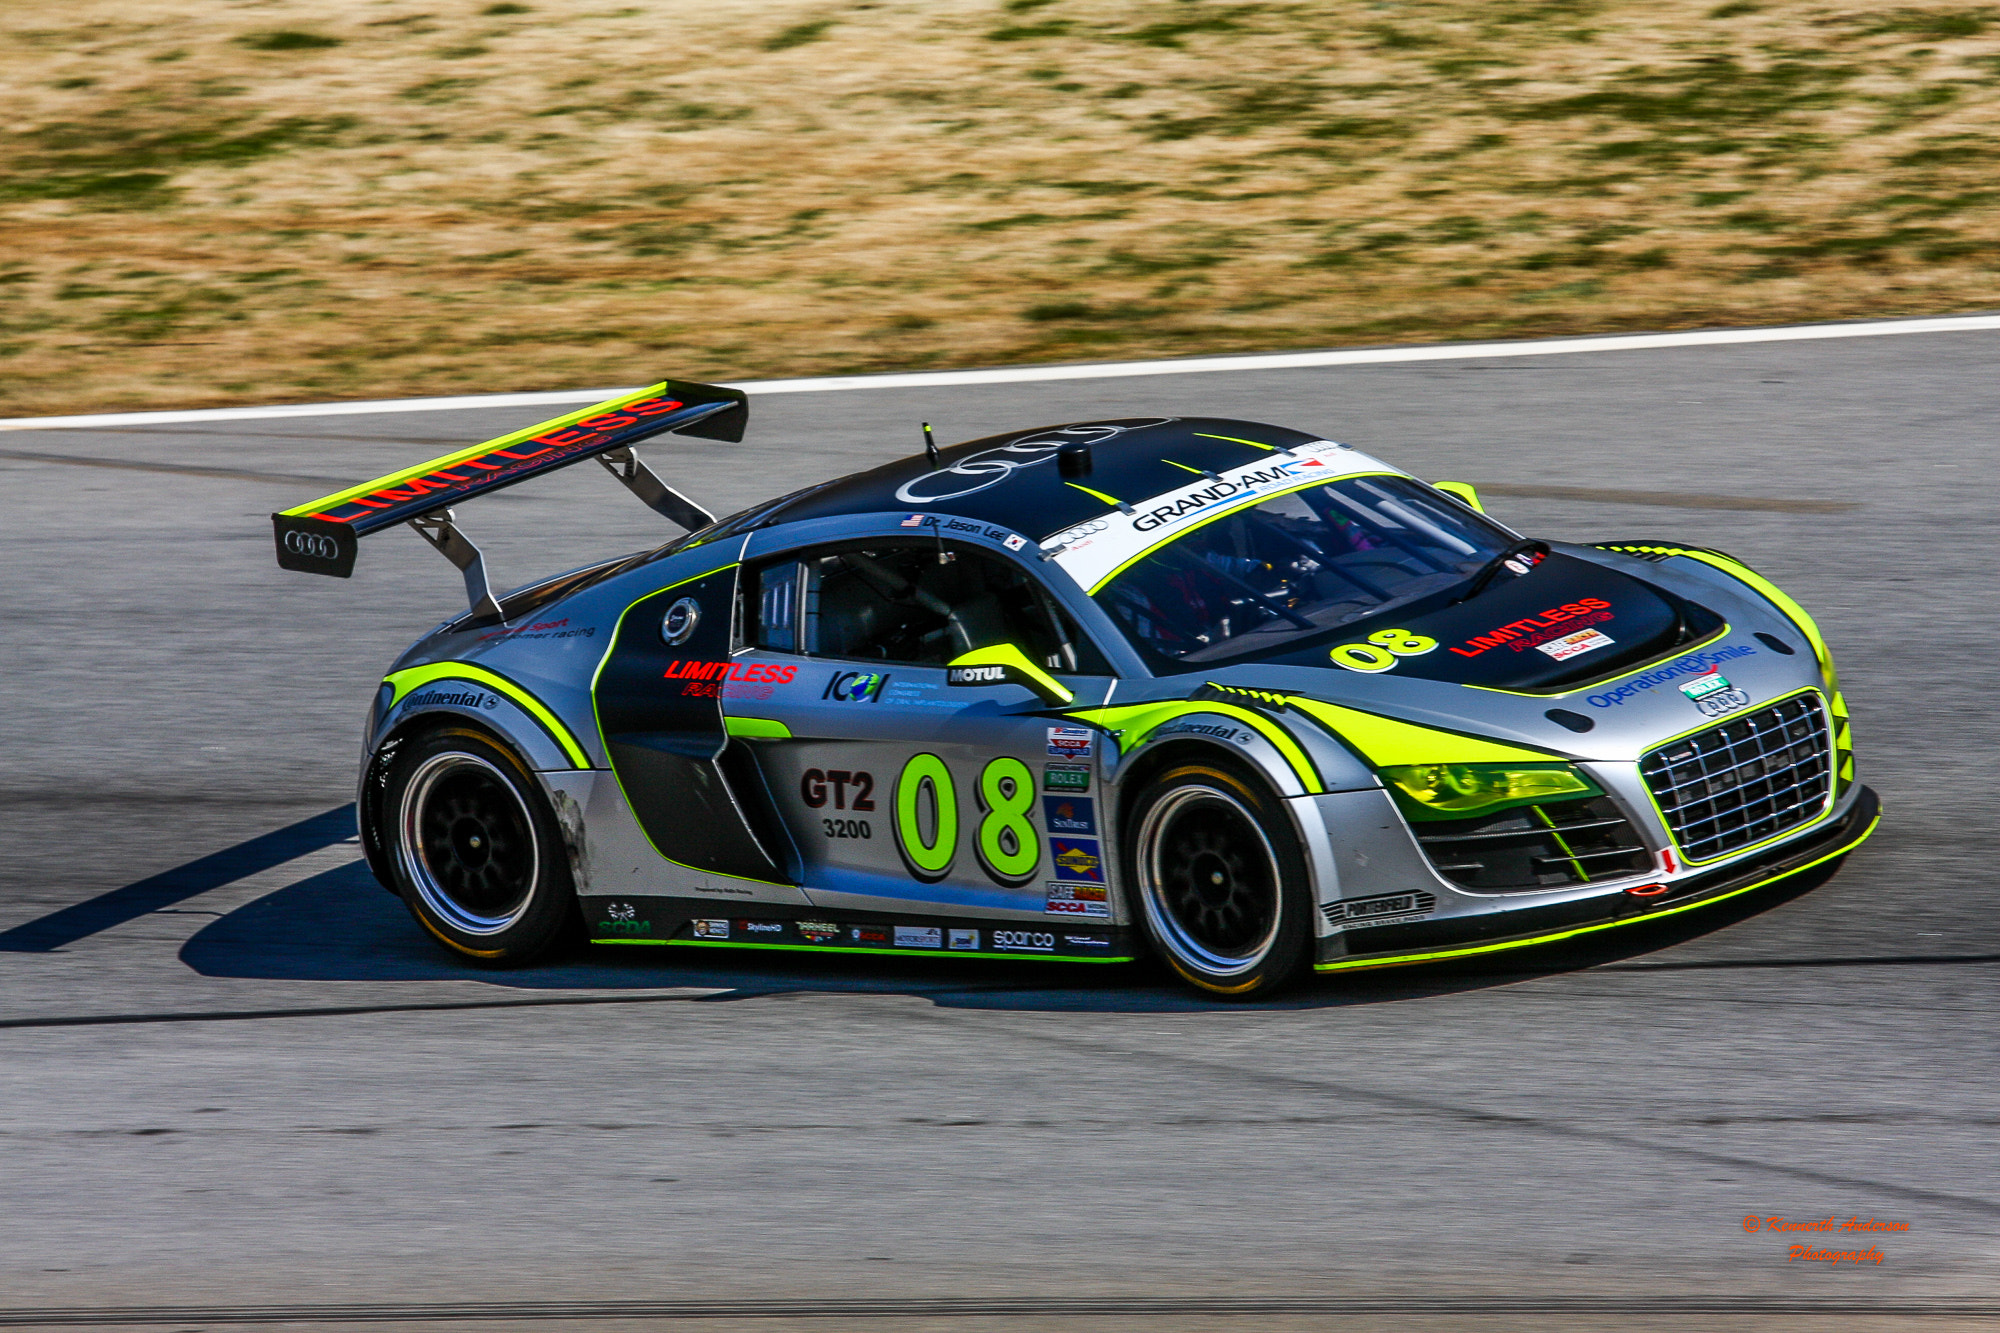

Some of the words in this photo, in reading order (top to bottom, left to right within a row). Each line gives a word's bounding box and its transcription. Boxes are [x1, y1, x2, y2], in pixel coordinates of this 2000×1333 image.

[311, 398, 684, 523] LIMITLESS
[943, 519, 981, 534] Jason
[984, 525, 1005, 540] Lee
[552, 627, 595, 638] racing
[1449, 598, 1612, 658] LIMITLESS
[1507, 611, 1615, 652] RACING
[1329, 628, 1439, 674] 08
[1552, 643, 1592, 658] SCCA
[663, 660, 798, 684] LIMITLESS
[950, 666, 1006, 682] MOTUL
[1586, 662, 1689, 708] Operation
[1698, 645, 1758, 665] Smile
[401, 689, 485, 711] Continental
[1057, 740, 1081, 748] SCCA
[801, 768, 875, 811] GT2
[1049, 772, 1083, 785] ROLEX
[822, 818, 871, 840] 3200
[892, 752, 1041, 888] 08
[1046, 901, 1086, 913] SCCA
[993, 930, 1054, 950] sparco
